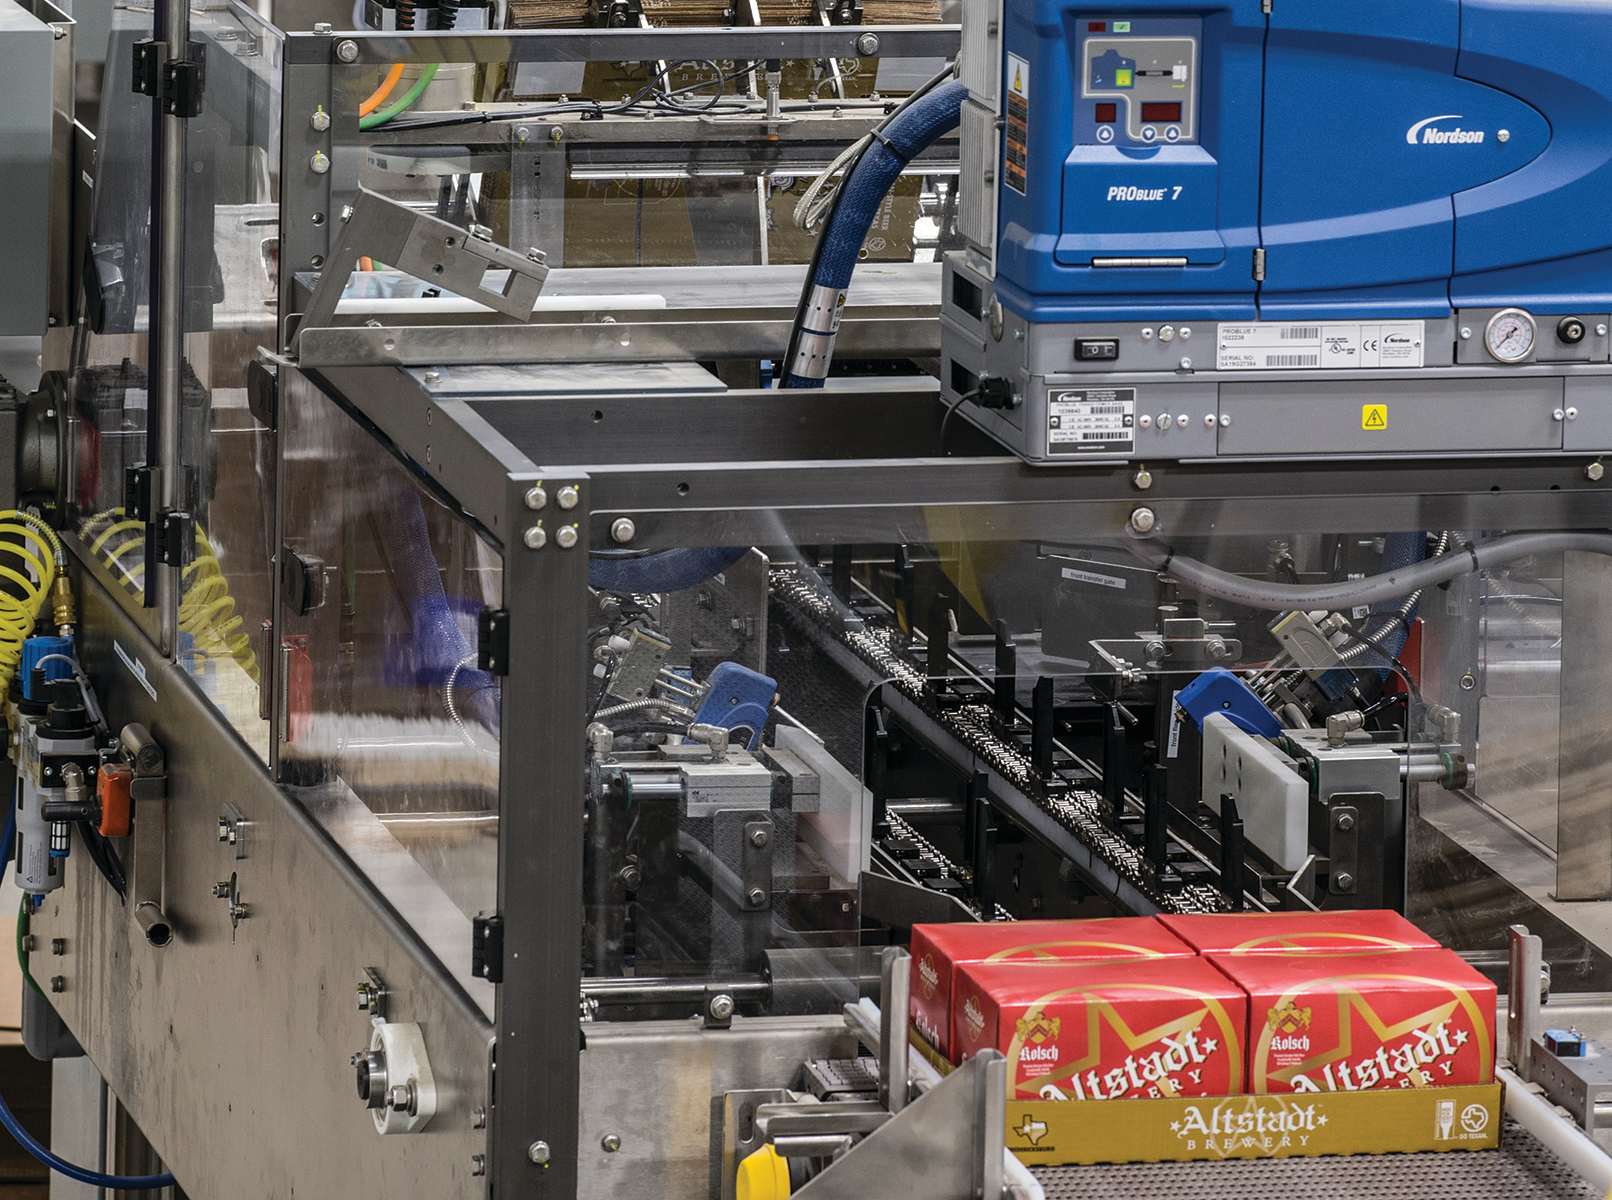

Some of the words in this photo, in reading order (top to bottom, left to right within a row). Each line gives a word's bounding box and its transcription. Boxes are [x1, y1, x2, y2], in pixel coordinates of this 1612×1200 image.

[1422, 127, 1485, 144] Nordson
[1171, 185, 1183, 201] 7
[881, 214, 891, 231] BEER
[1084, 574, 1104, 583] transfer
[1104, 578, 1116, 586] gate
[1270, 1035, 1311, 1052] Kolsch
[1020, 1045, 1059, 1062] Kolsch
[1177, 1102, 1318, 1139] Altstadt
[1186, 1135, 1311, 1151] BREWERY
